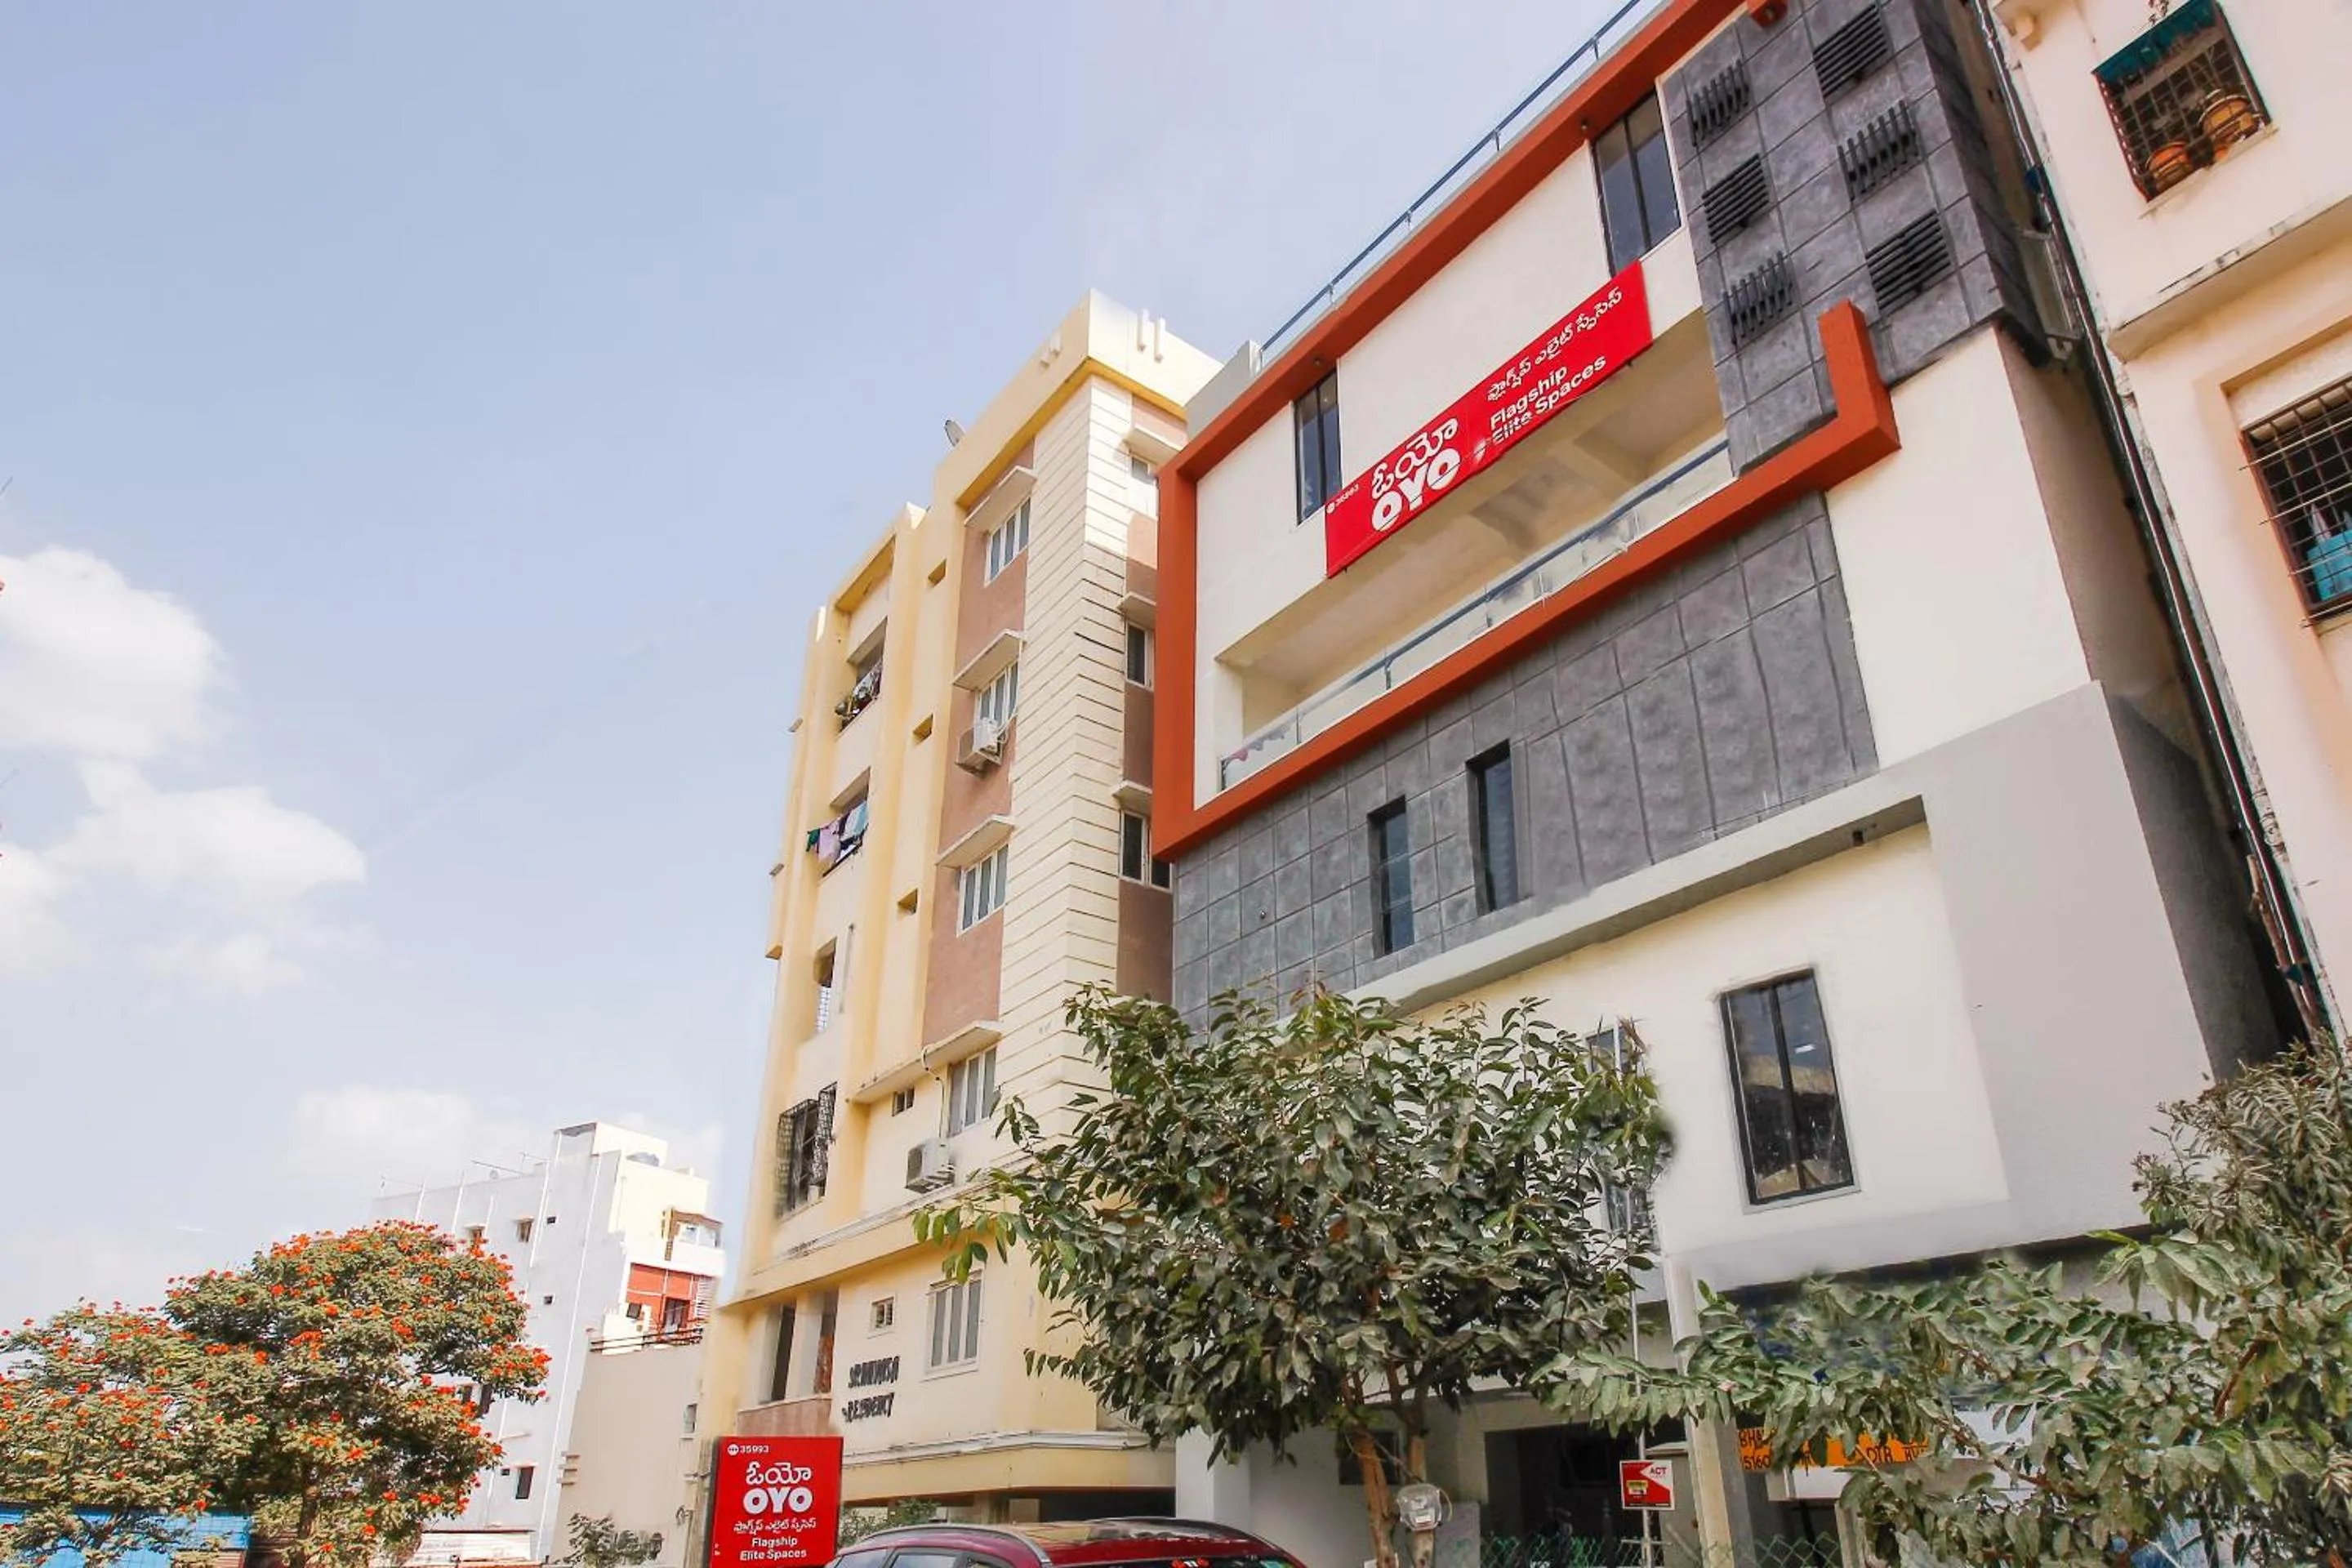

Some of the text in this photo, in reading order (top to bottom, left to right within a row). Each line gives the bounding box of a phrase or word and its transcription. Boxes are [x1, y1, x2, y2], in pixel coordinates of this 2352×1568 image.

[1490, 367, 1568, 430] Flagship
[1491, 356, 1607, 445] Elite Spaces
[1372, 417, 1459, 499] ఓయో
[1372, 448, 1461, 532] OYO
[746, 1461, 812, 1485] ఓయో
[743, 1486, 813, 1514] OYO
[739, 1549, 807, 1561] Elite Spaces
[751, 1536, 798, 1548] Flagship
